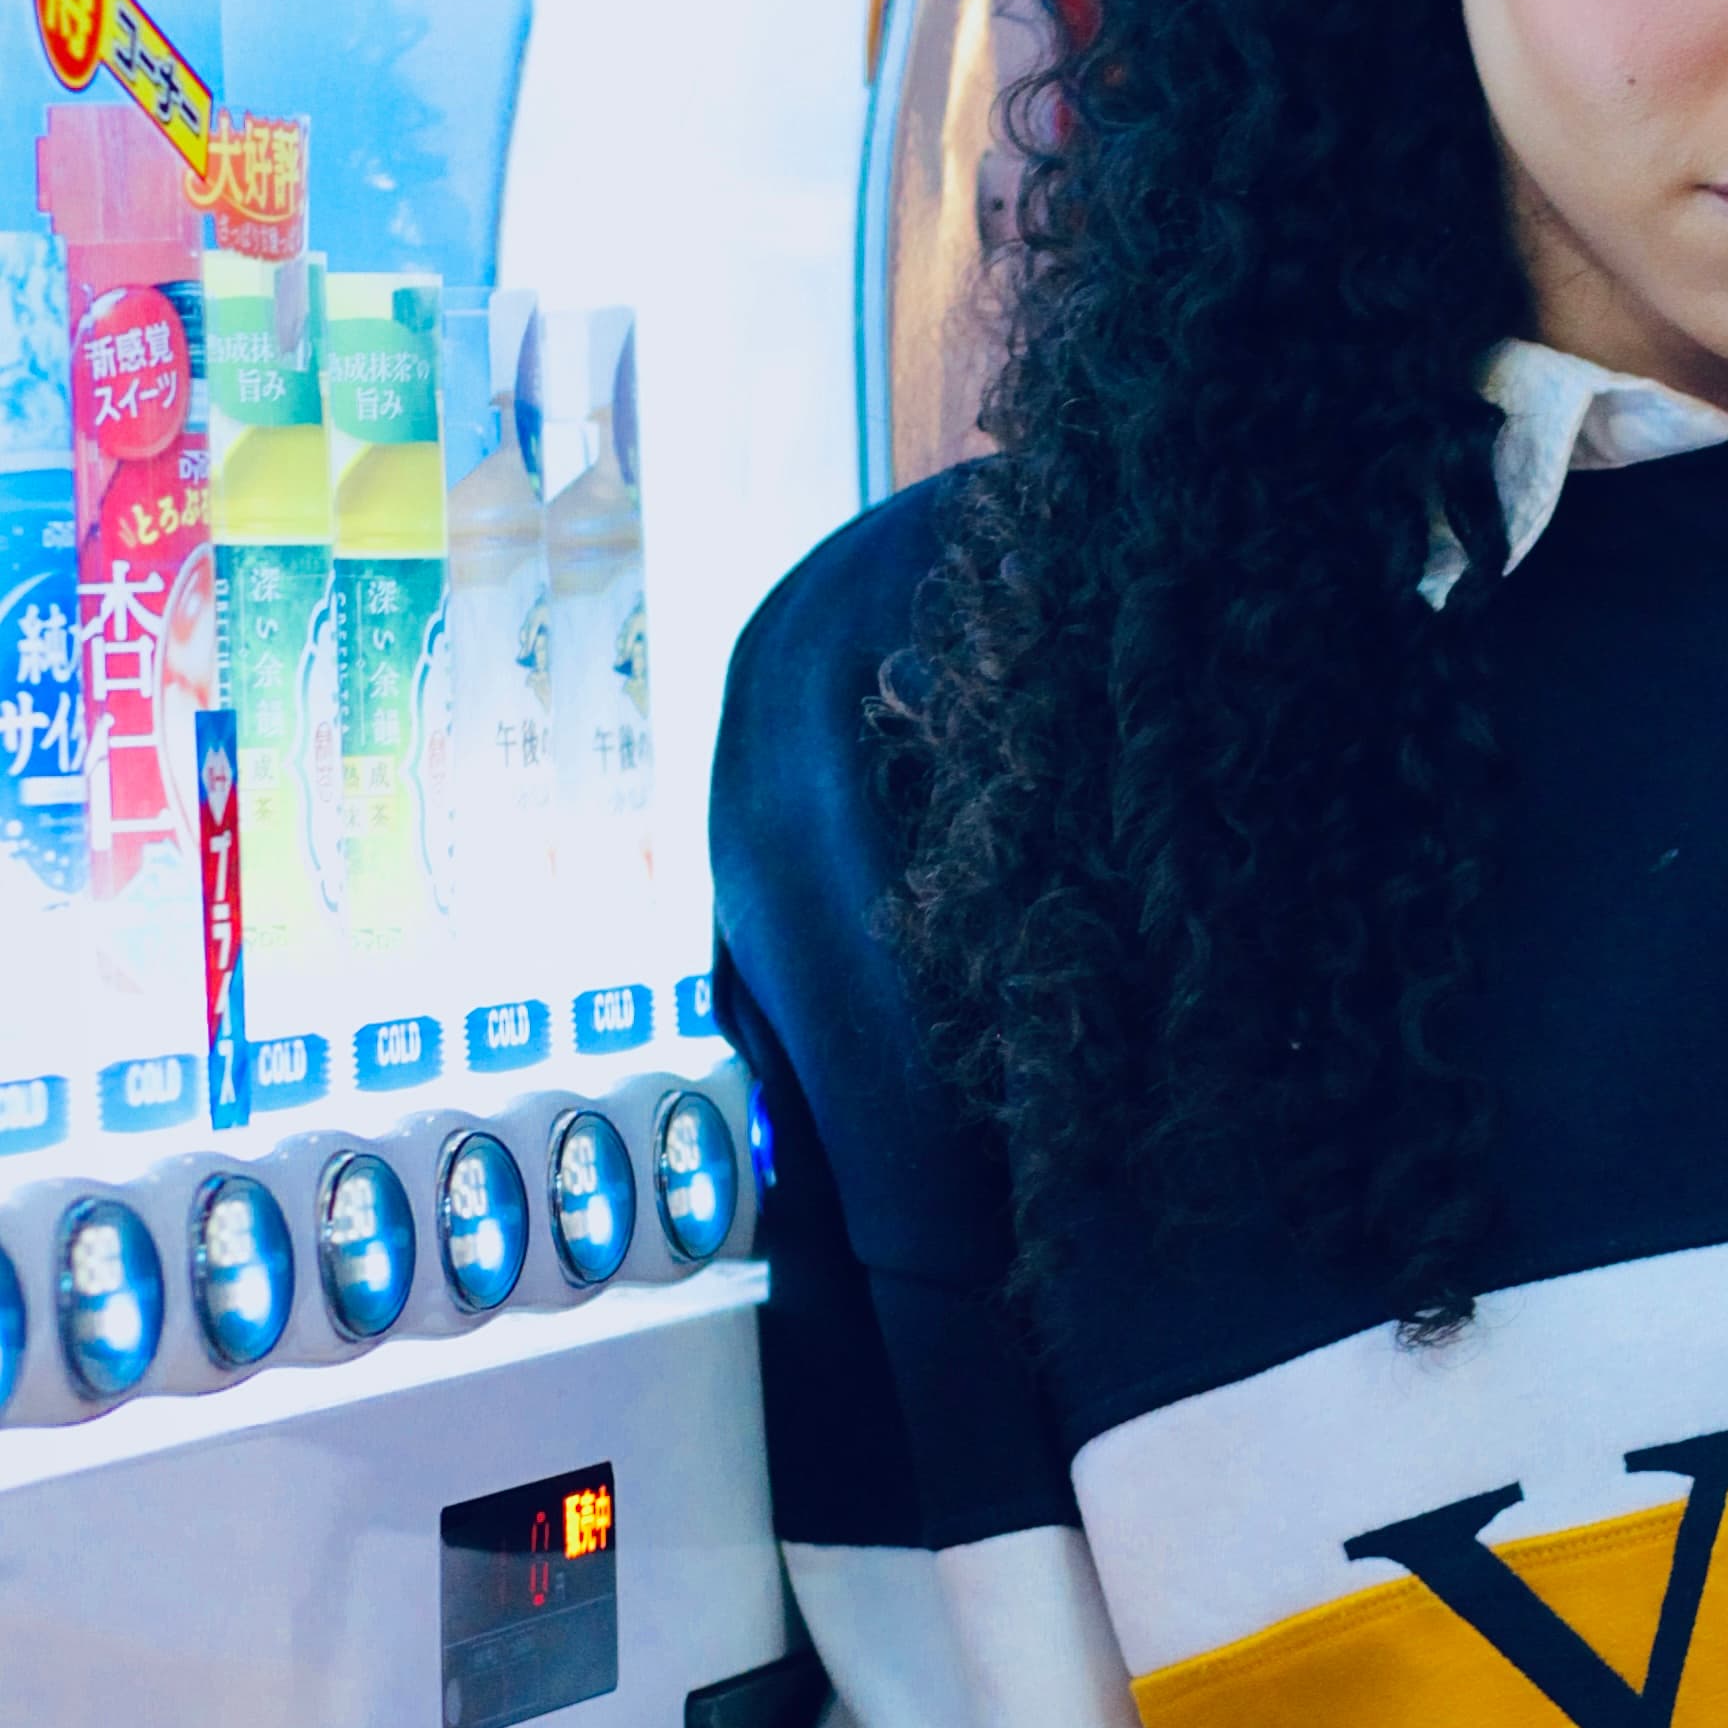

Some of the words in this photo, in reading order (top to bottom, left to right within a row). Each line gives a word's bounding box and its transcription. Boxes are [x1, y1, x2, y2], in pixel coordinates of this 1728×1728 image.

[84, 321, 174, 381] 新感覚
[94, 369, 178, 426] スイーツ
[237, 367, 286, 404] 旨み
[356, 385, 405, 422] 旨み
[77, 559, 182, 852] 杏仁
[487, 1004, 530, 1048] COLD
[593, 989, 634, 1033] COLD
[257, 1039, 307, 1086] COLD
[376, 1021, 421, 1067] COLD
[126, 1058, 182, 1107] COLD
